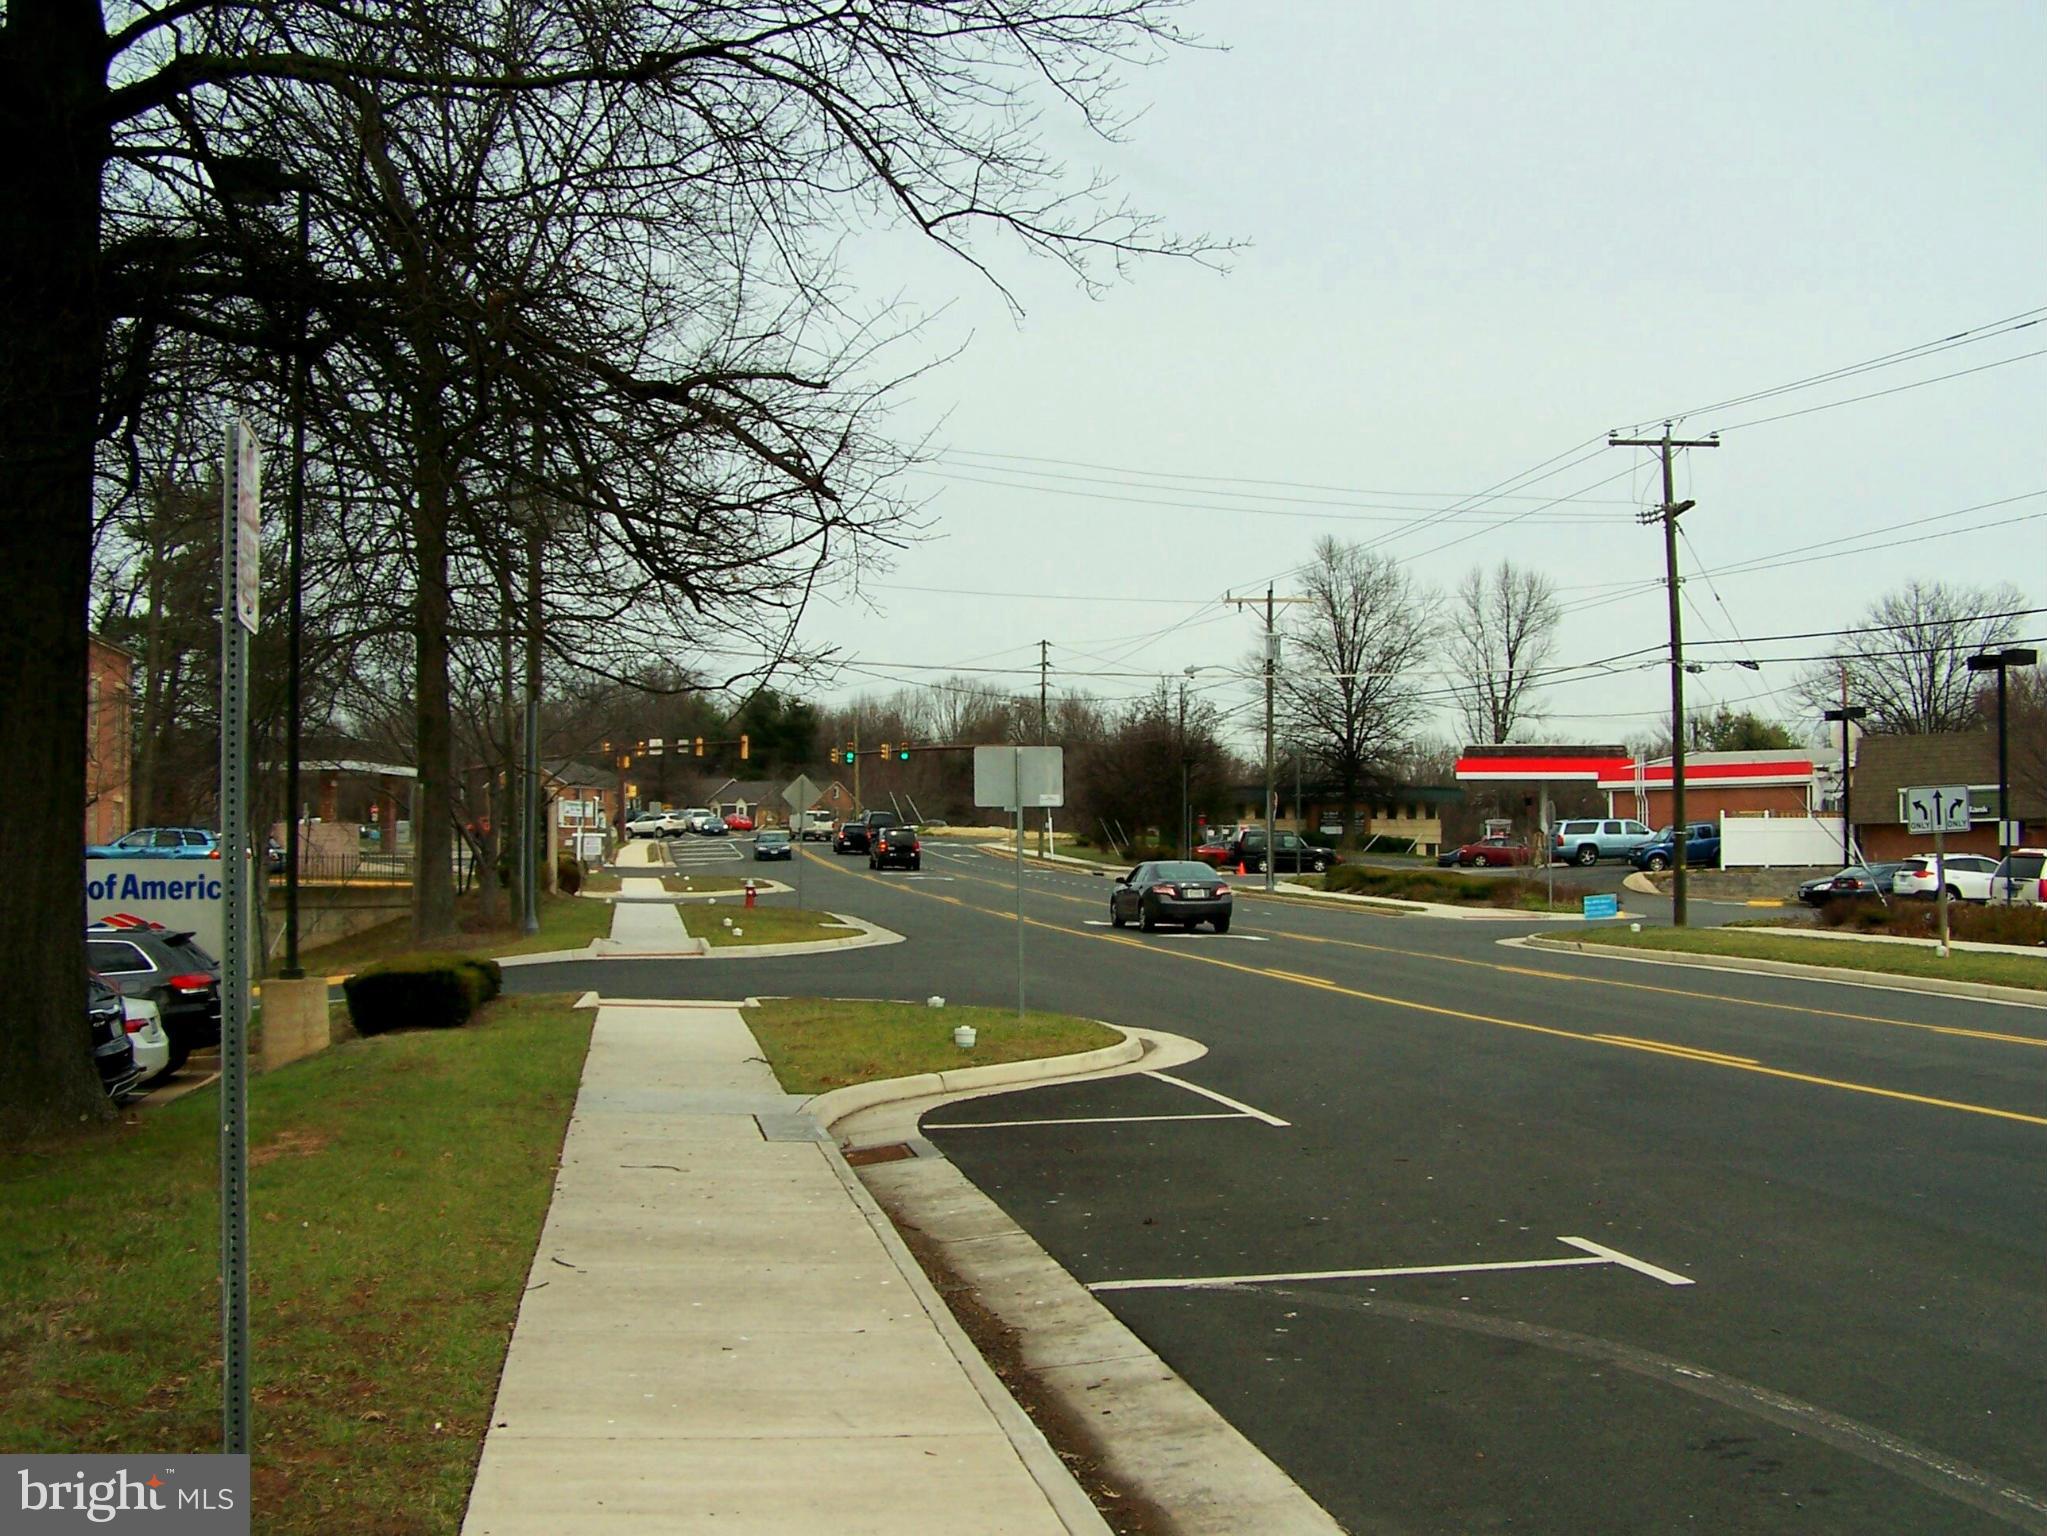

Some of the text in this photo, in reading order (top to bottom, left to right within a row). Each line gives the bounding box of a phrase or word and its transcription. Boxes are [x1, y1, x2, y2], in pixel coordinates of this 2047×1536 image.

[1911, 821, 1931, 830] ONLY
[1947, 819, 1967, 829] ONLY
[87, 873, 222, 901] of Americ
